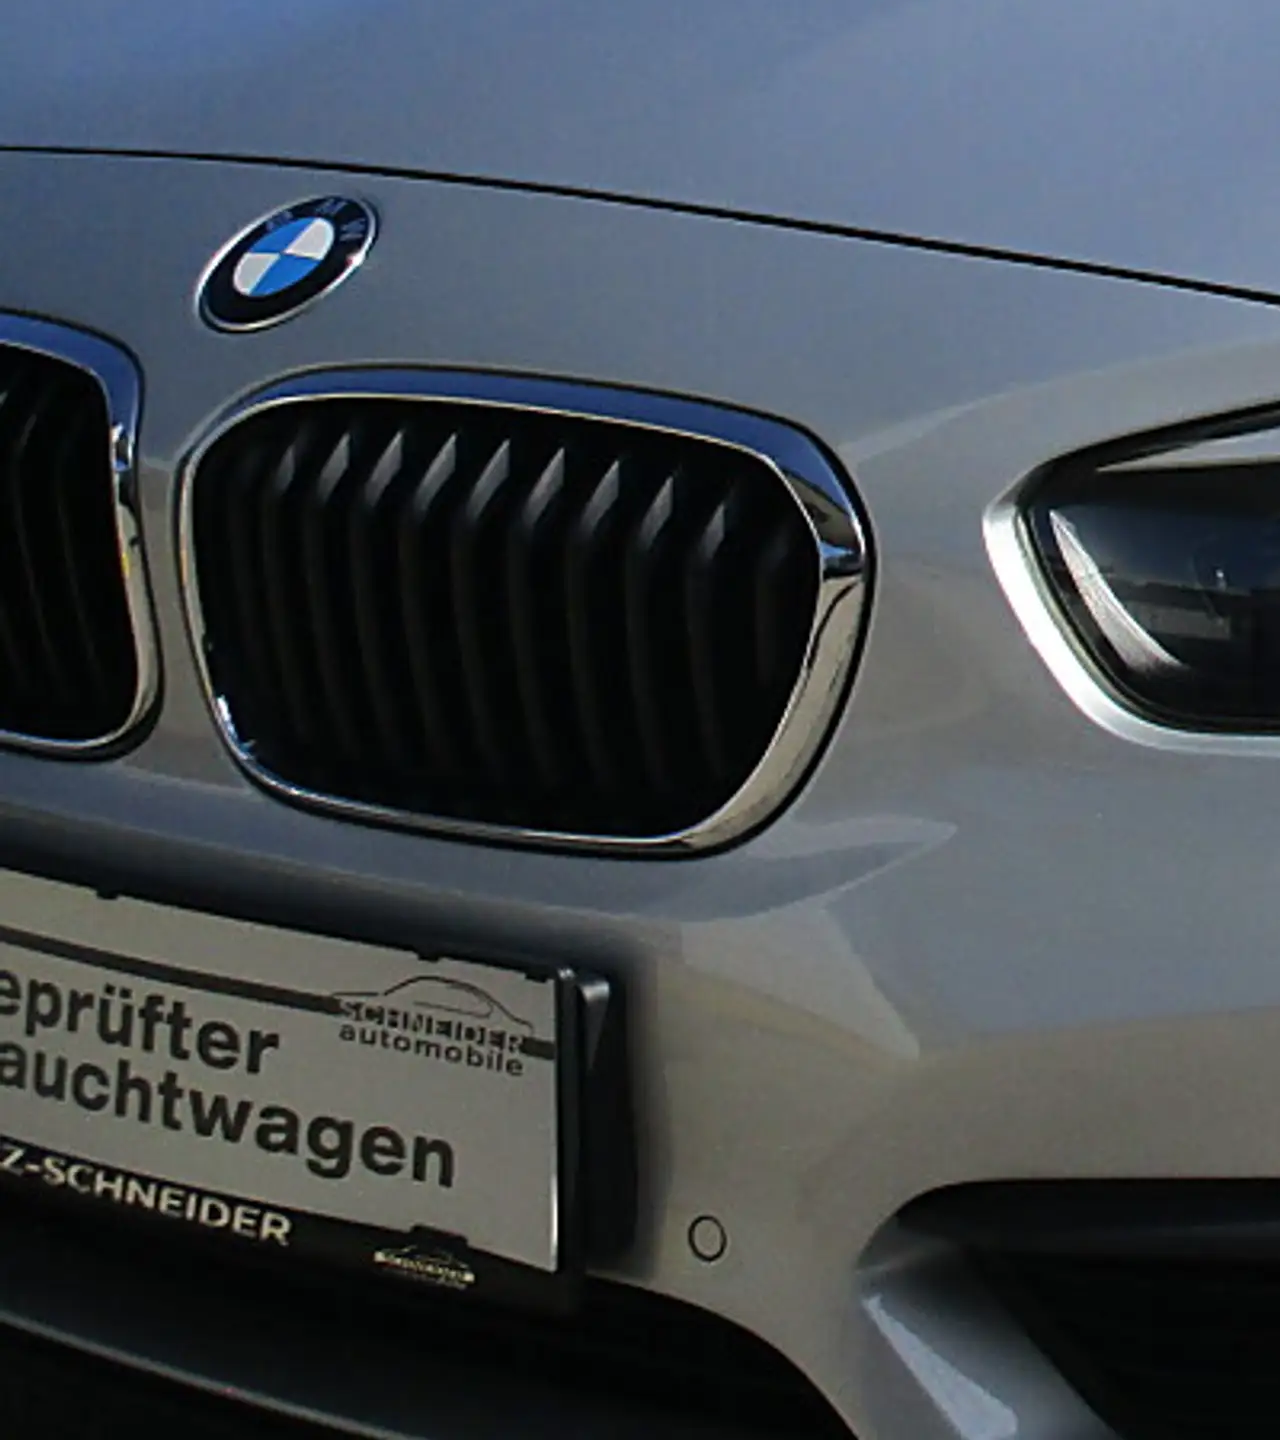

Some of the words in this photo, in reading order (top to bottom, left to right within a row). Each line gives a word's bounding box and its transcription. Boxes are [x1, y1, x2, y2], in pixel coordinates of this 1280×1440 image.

[264, 198, 368, 244] BMW
[338, 1023, 524, 1077] automobile
[343, 1000, 524, 1054] SCHNEIDER
